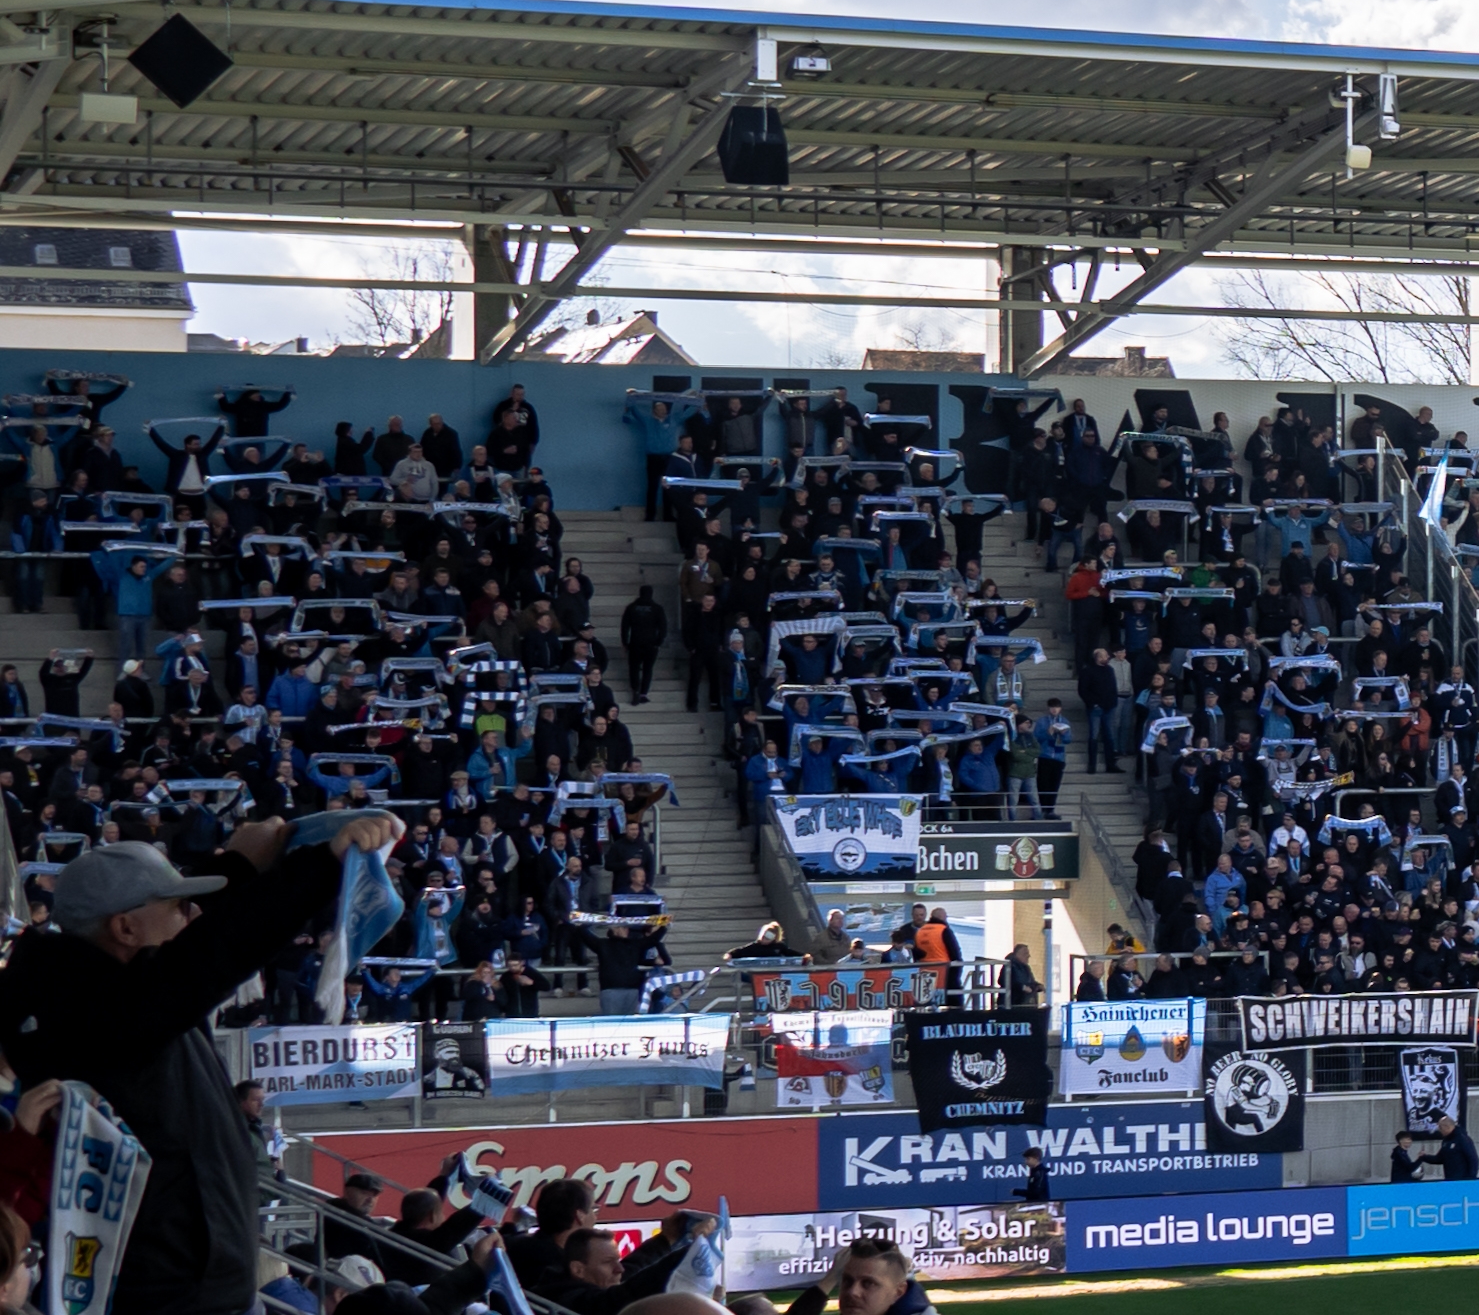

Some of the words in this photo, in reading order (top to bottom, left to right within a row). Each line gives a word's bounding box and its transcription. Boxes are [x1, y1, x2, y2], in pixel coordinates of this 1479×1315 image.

[917, 844, 979, 873] ßchen
[1082, 1004, 1189, 1025] Hainichener
[1249, 998, 1472, 1042] SCHWEIKERSHAIN
[921, 1019, 1033, 1041] BLAUBLÜTER
[253, 1034, 416, 1069] BIERDURST
[505, 1037, 631, 1066] Chemnitzer
[638, 1035, 710, 1061] Jungs
[254, 1068, 417, 1094] KARL-MARX-STADT
[1098, 1067, 1170, 1088] Fanclub
[1210, 1051, 1242, 1077] BEER
[1251, 1051, 1270, 1064] NO
[1268, 1053, 1299, 1097] GLORY
[944, 1100, 1025, 1120] CHEMNITZ
[1092, 1153, 1259, 1174] TRANSPORTBETRIEB
[815, 1219, 929, 1251] Heizung
[937, 1219, 957, 1242] &
[963, 1216, 1035, 1241] Solar
[1086, 1216, 1200, 1249] media
[1206, 1210, 1335, 1245] lounge
[778, 1255, 833, 1276] effizi
[953, 1245, 1050, 1267] nachhaltig
